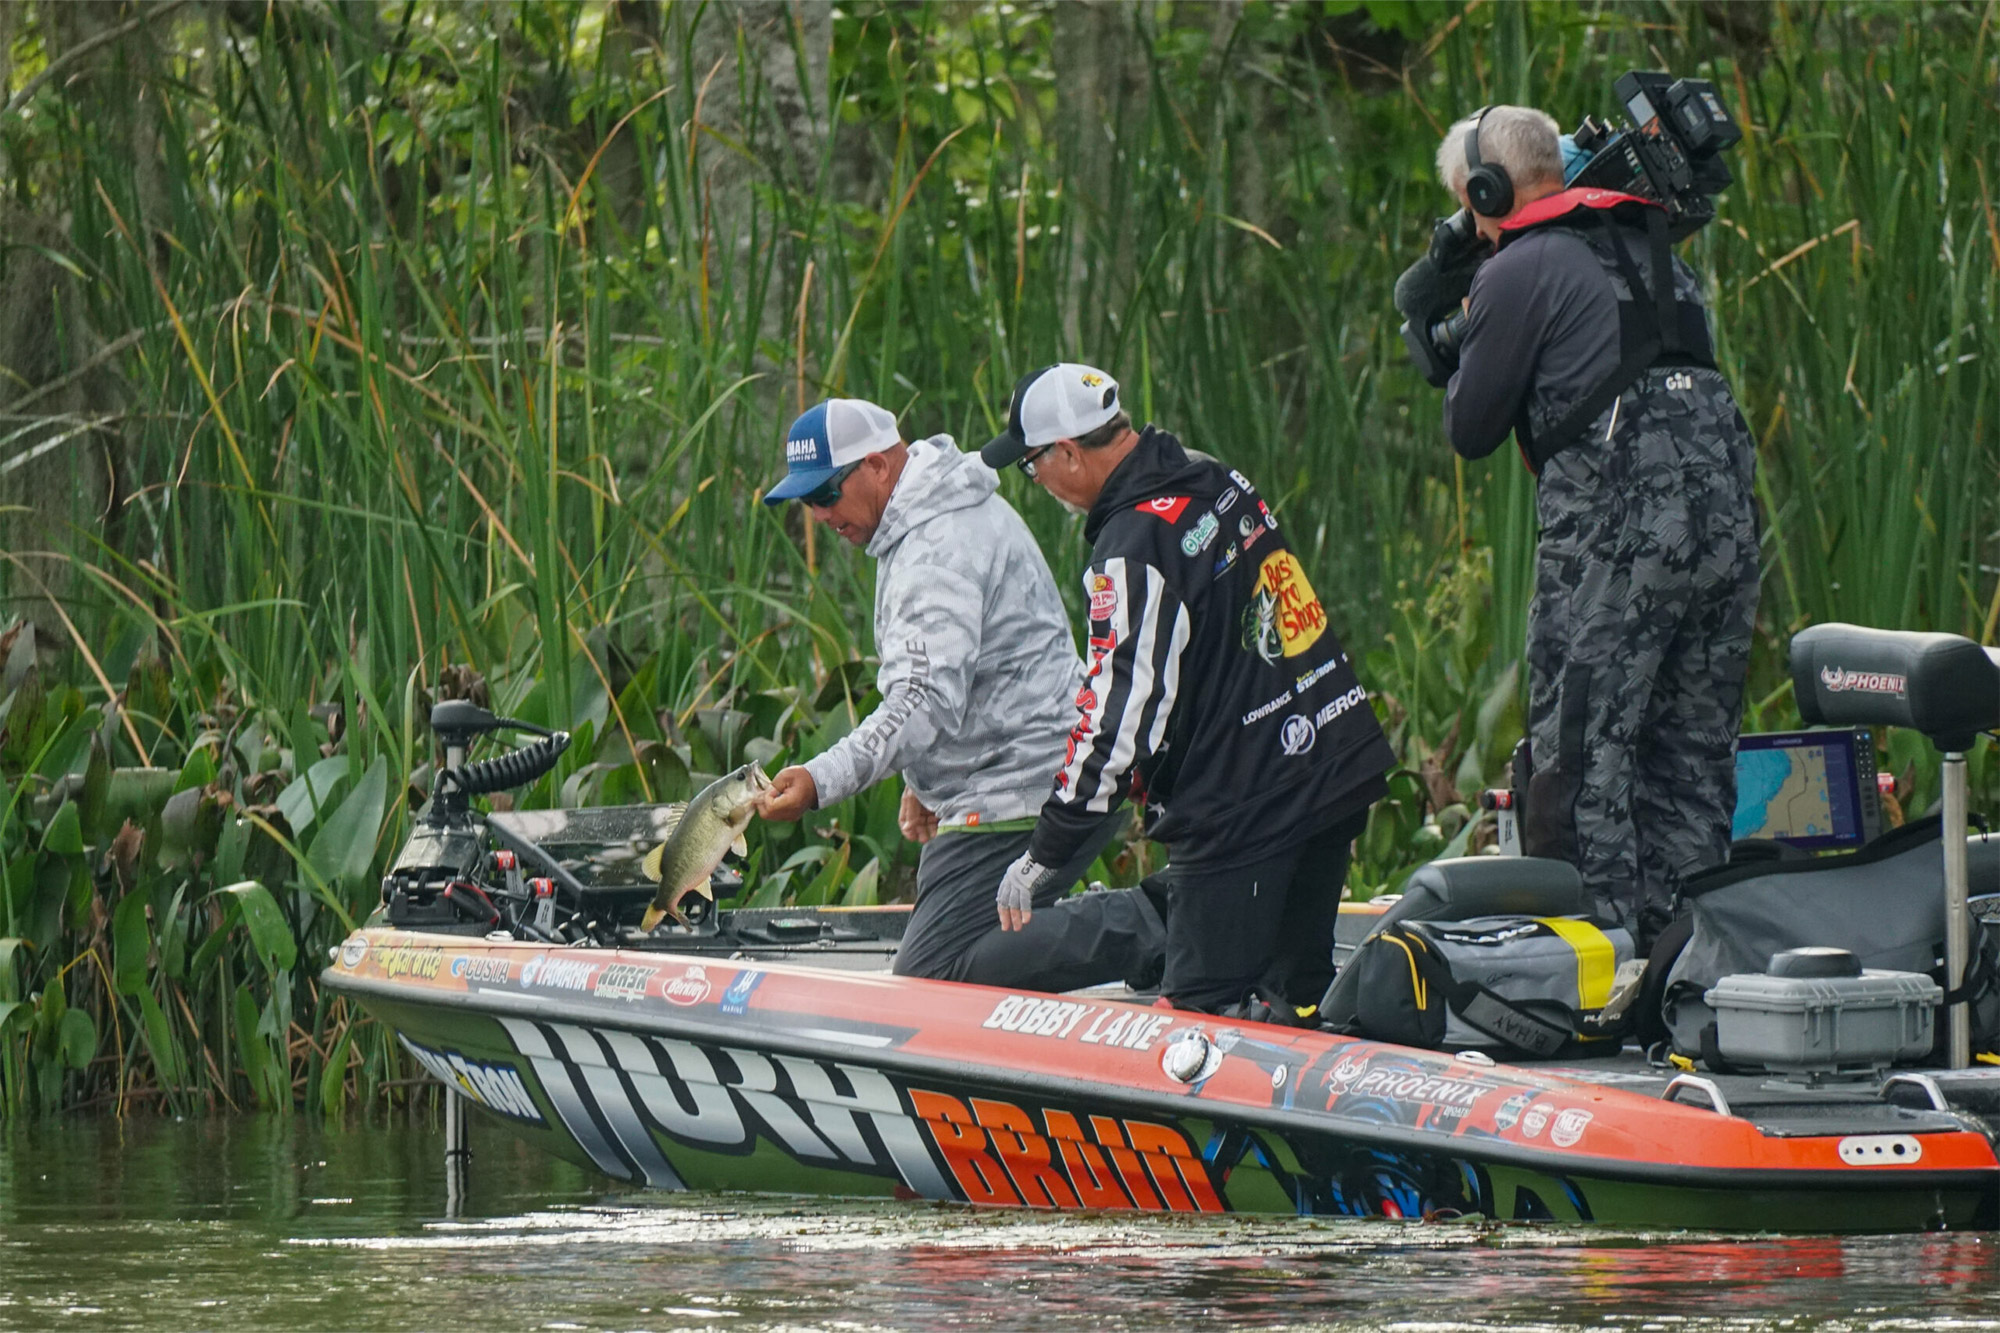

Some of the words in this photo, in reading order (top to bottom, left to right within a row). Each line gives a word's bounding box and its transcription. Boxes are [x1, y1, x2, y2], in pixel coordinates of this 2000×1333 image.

[1666, 372, 1691, 390] Gill
[1844, 672, 1905, 692] PHOENIX
[1242, 690, 1293, 725] LOWRANCE
[1316, 684, 1367, 730] MERCU
[466, 957, 510, 984] COSTA
[536, 957, 598, 992] YAMAHA
[667, 978, 707, 1000] Berkley
[982, 994, 1095, 1039] BOBBY
[1080, 1007, 1175, 1051] LANE
[1352, 1068, 1493, 1107] PHOENIX
[907, 1088, 1224, 1212] BRAID
